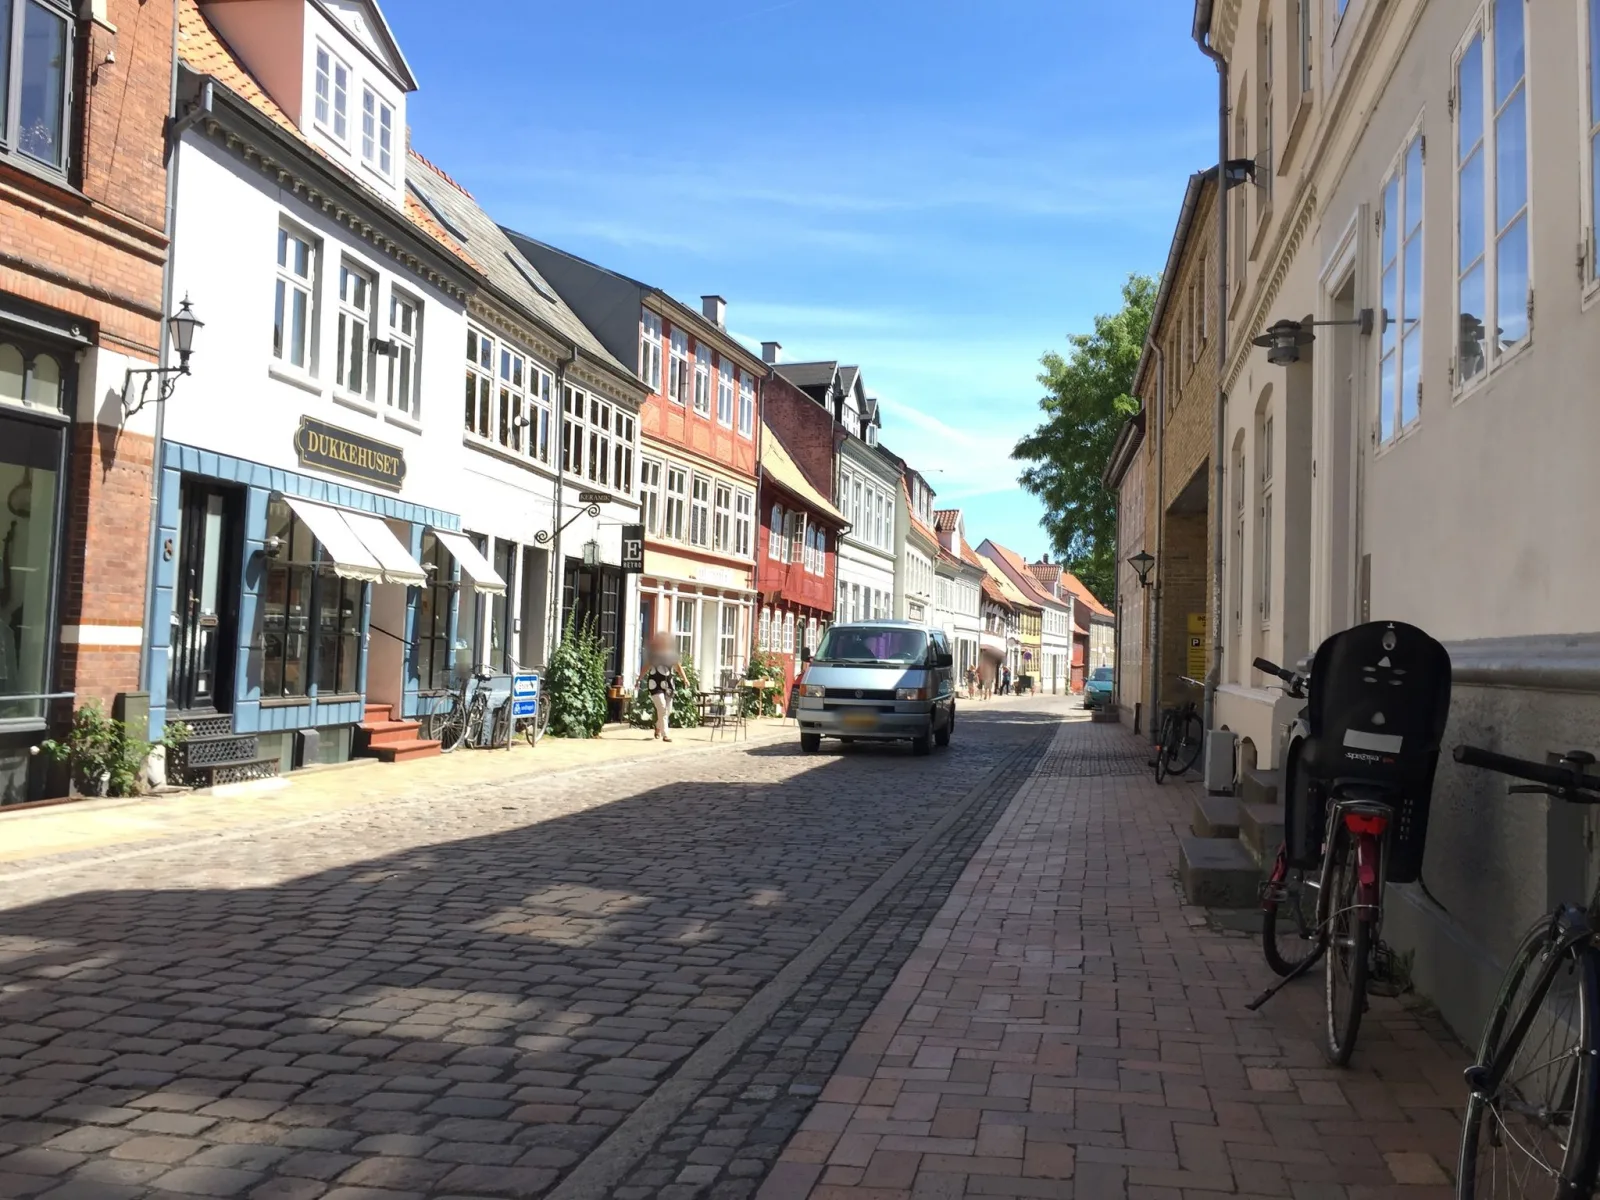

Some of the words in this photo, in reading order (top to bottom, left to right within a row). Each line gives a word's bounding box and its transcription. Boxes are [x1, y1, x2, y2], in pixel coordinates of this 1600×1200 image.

[307, 430, 399, 476] DUKKEHUSET
[580, 494, 610, 502] KERAMIK
[623, 539, 642, 561] E
